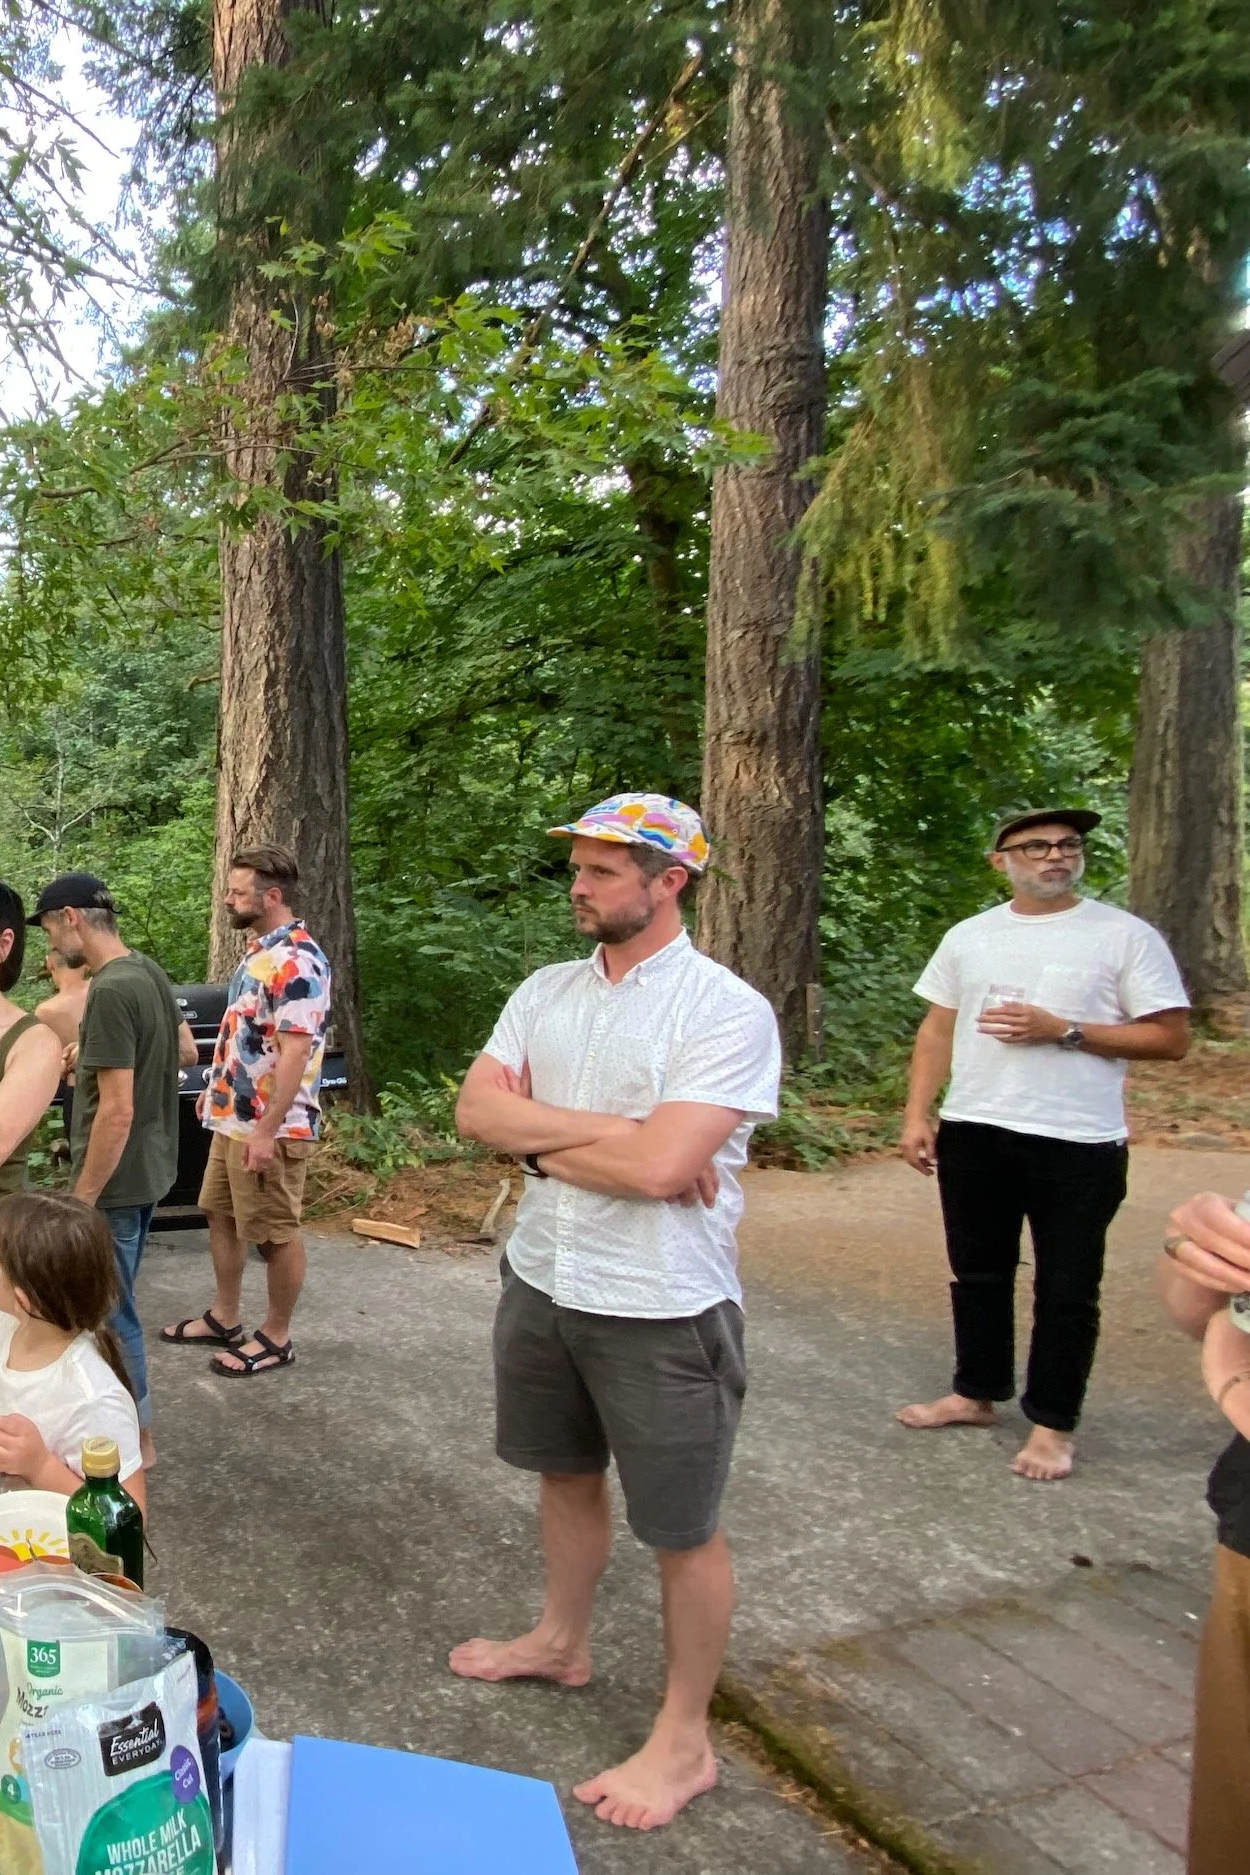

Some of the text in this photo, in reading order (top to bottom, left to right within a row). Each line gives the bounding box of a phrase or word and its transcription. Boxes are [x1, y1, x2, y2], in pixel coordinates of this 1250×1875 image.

[30, 1646, 57, 1665] 365
[27, 1682, 63, 1700] Organic
[110, 1718, 160, 1757] Essential
[111, 1740, 161, 1766] EVERYDAY
[174, 1758, 192, 1781] Classic
[182, 1774, 194, 1789] Cut
[106, 1807, 187, 1865] WHOLE MILK
